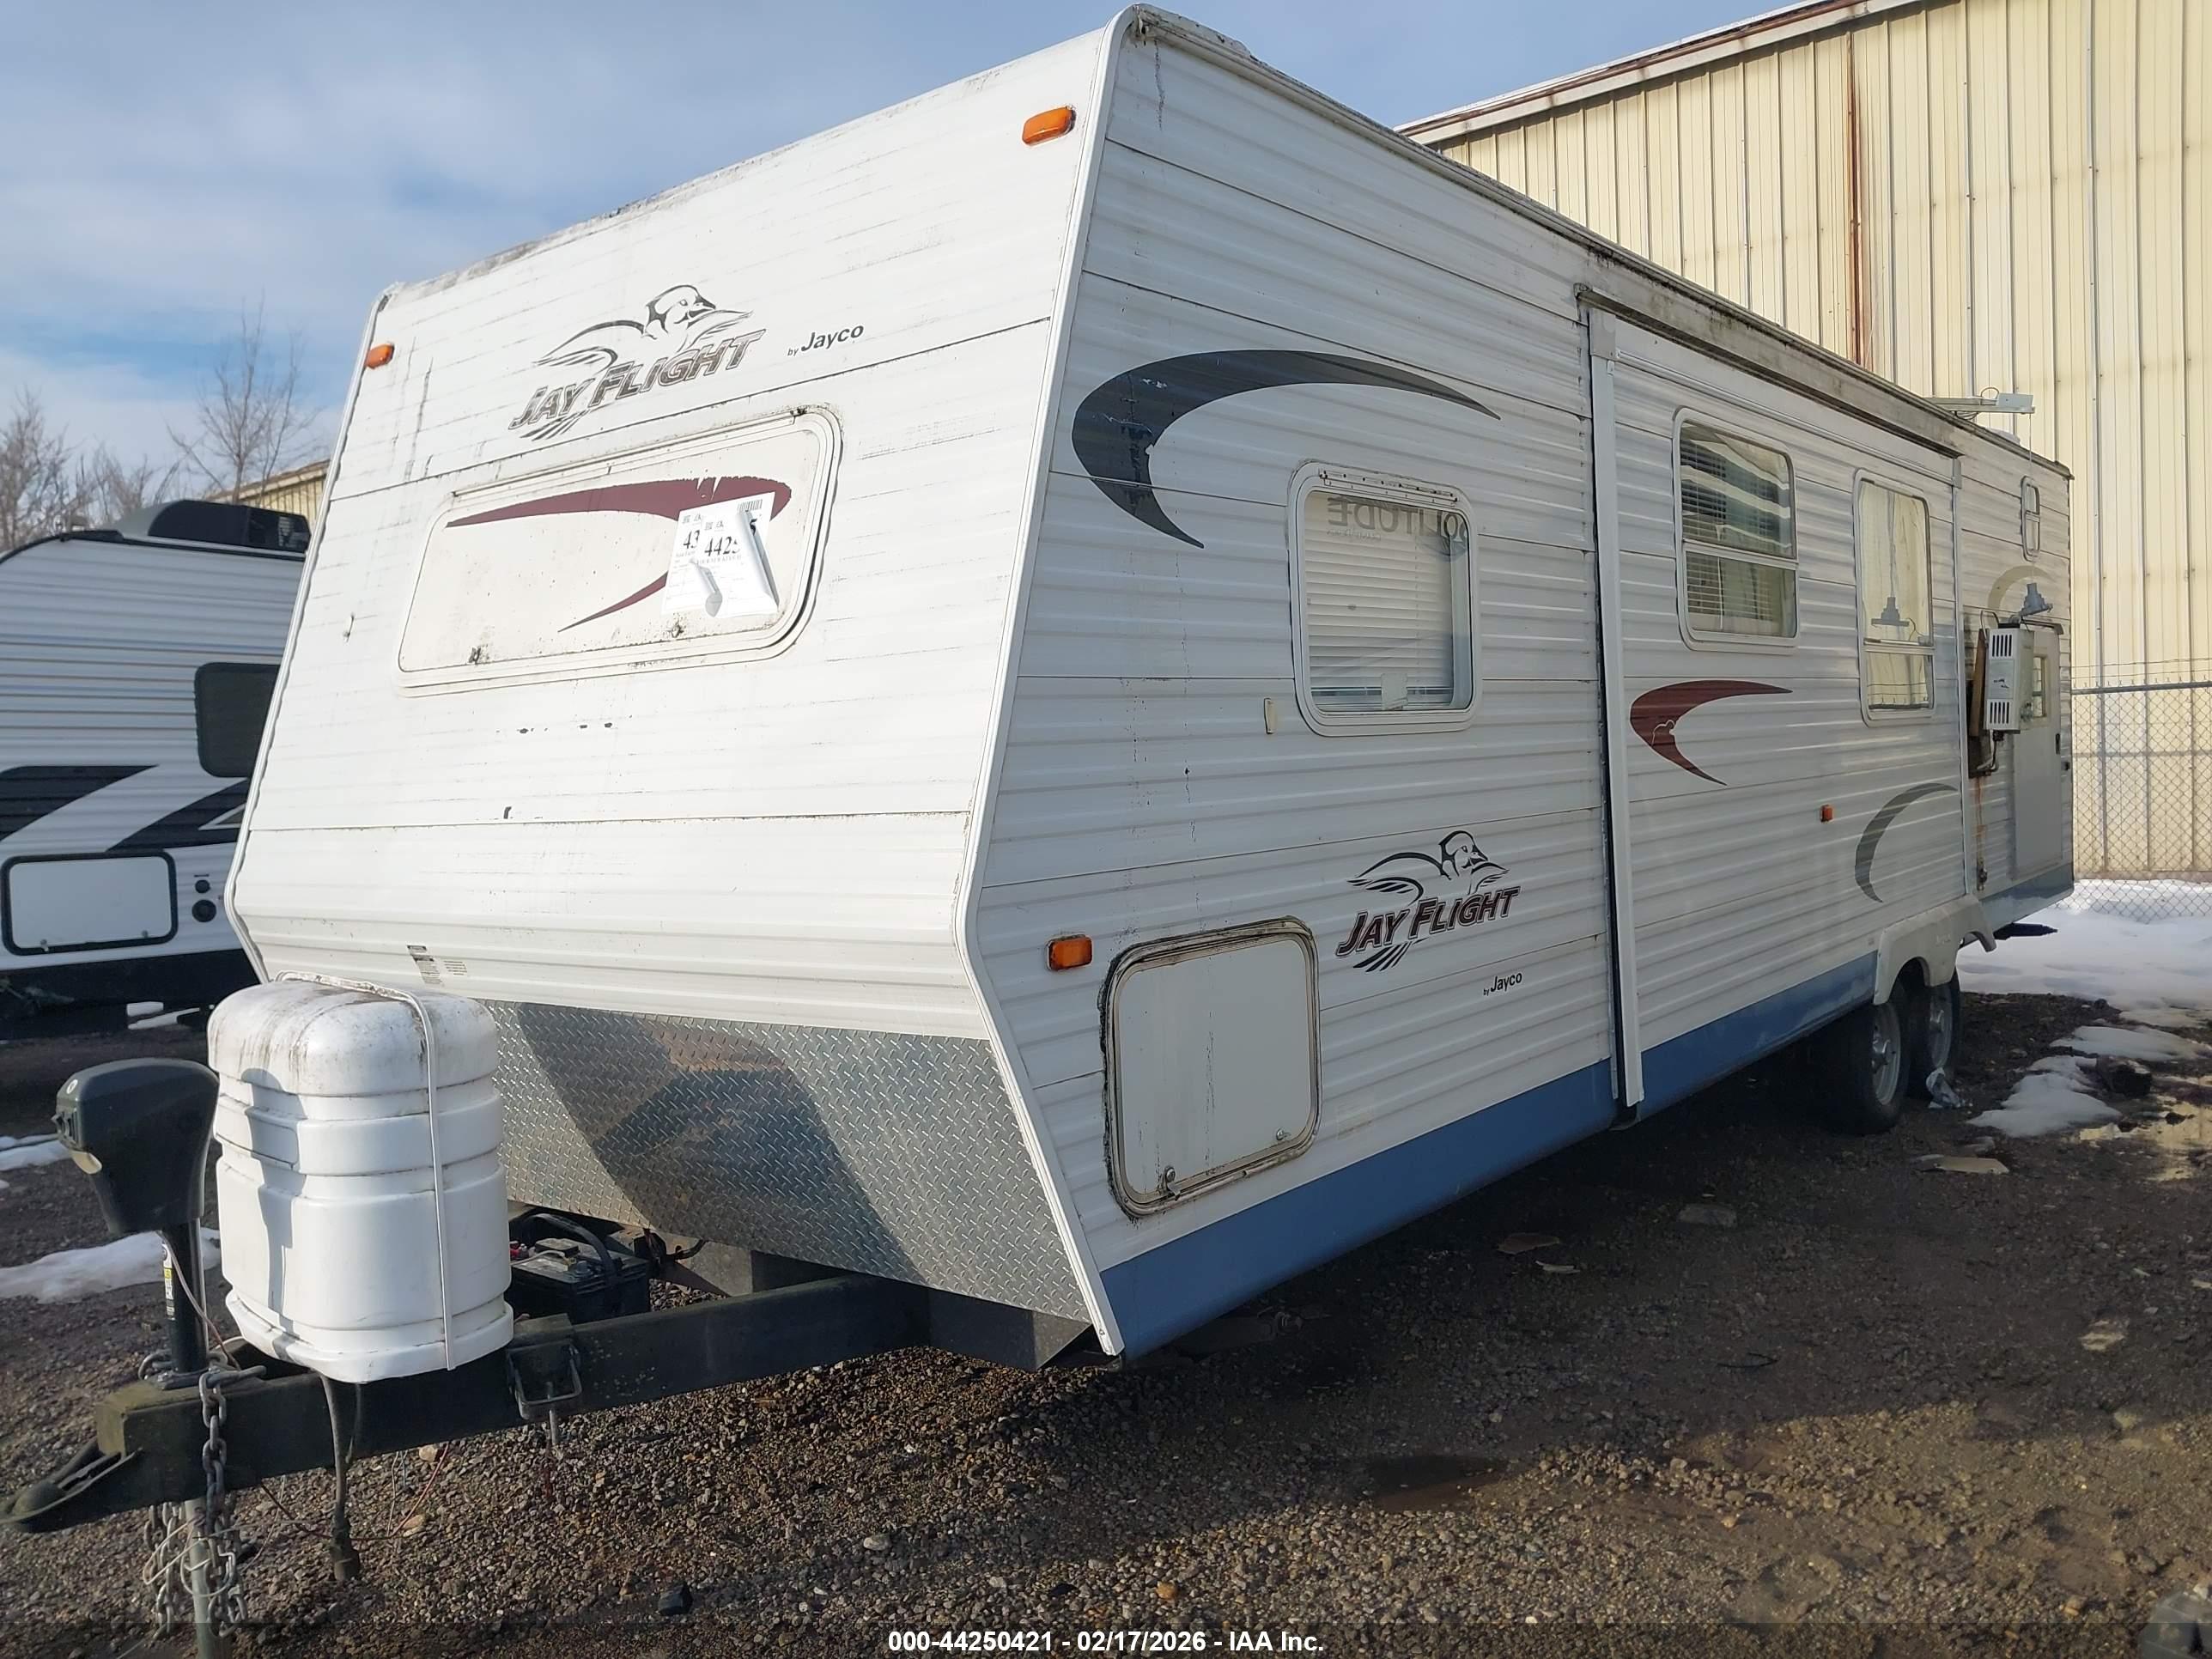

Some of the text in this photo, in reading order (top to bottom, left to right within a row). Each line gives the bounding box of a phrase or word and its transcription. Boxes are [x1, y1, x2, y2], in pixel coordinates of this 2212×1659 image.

[787, 324, 864, 357] by Jayco
[508, 329, 765, 429] JAY FLIGHT
[1335, 886, 1520, 958] JAY FLIGHT
[1483, 972, 1522, 996] by Jayco
